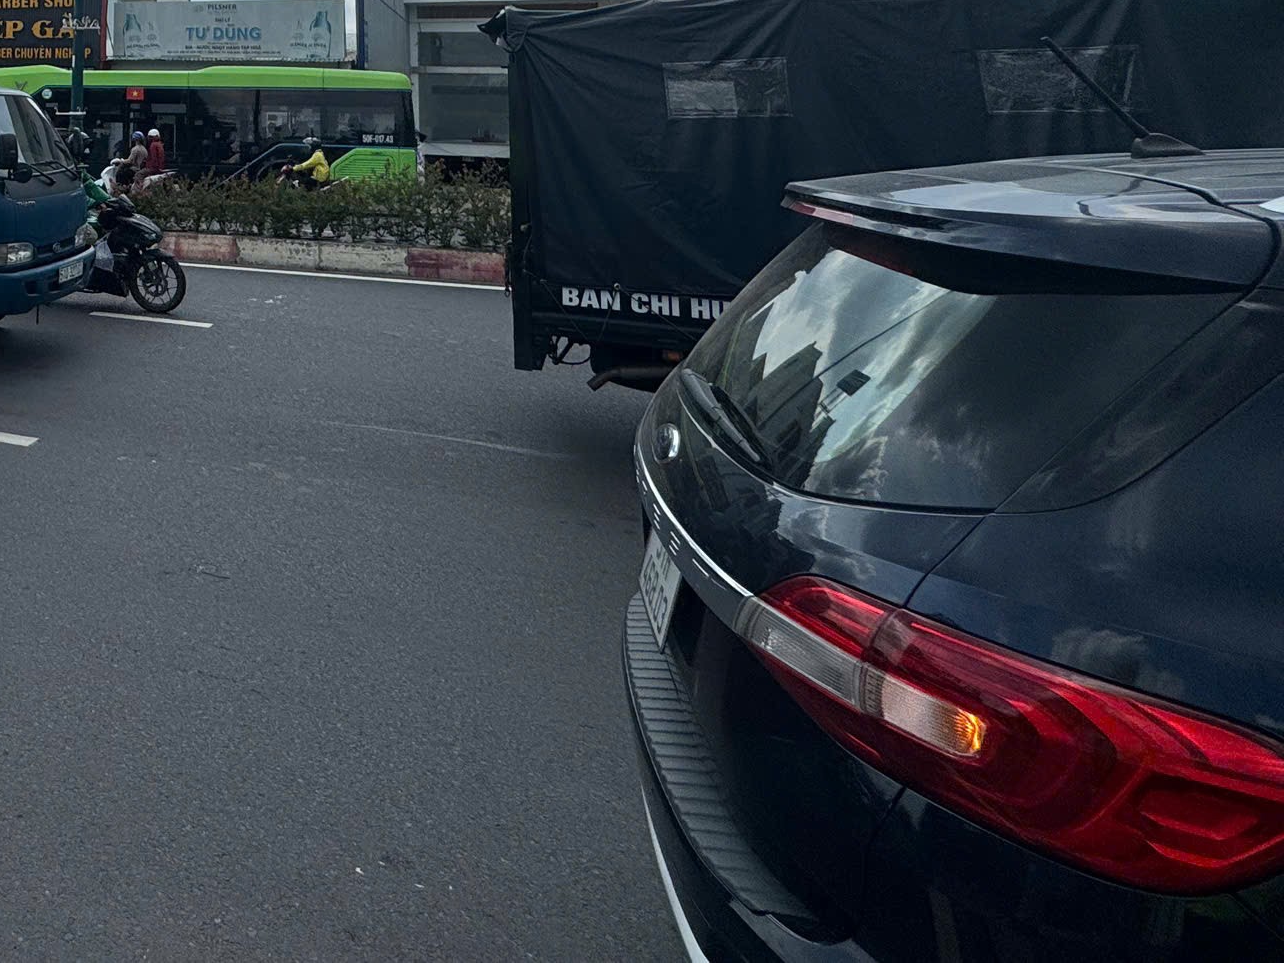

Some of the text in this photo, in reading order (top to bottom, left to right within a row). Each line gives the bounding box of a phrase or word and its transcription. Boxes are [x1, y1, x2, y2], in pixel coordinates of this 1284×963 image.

[207, 3, 237, 11] PILSNER
[14, 44, 53, 58] CHUYÊN
[54, 46, 92, 58] NGHP
